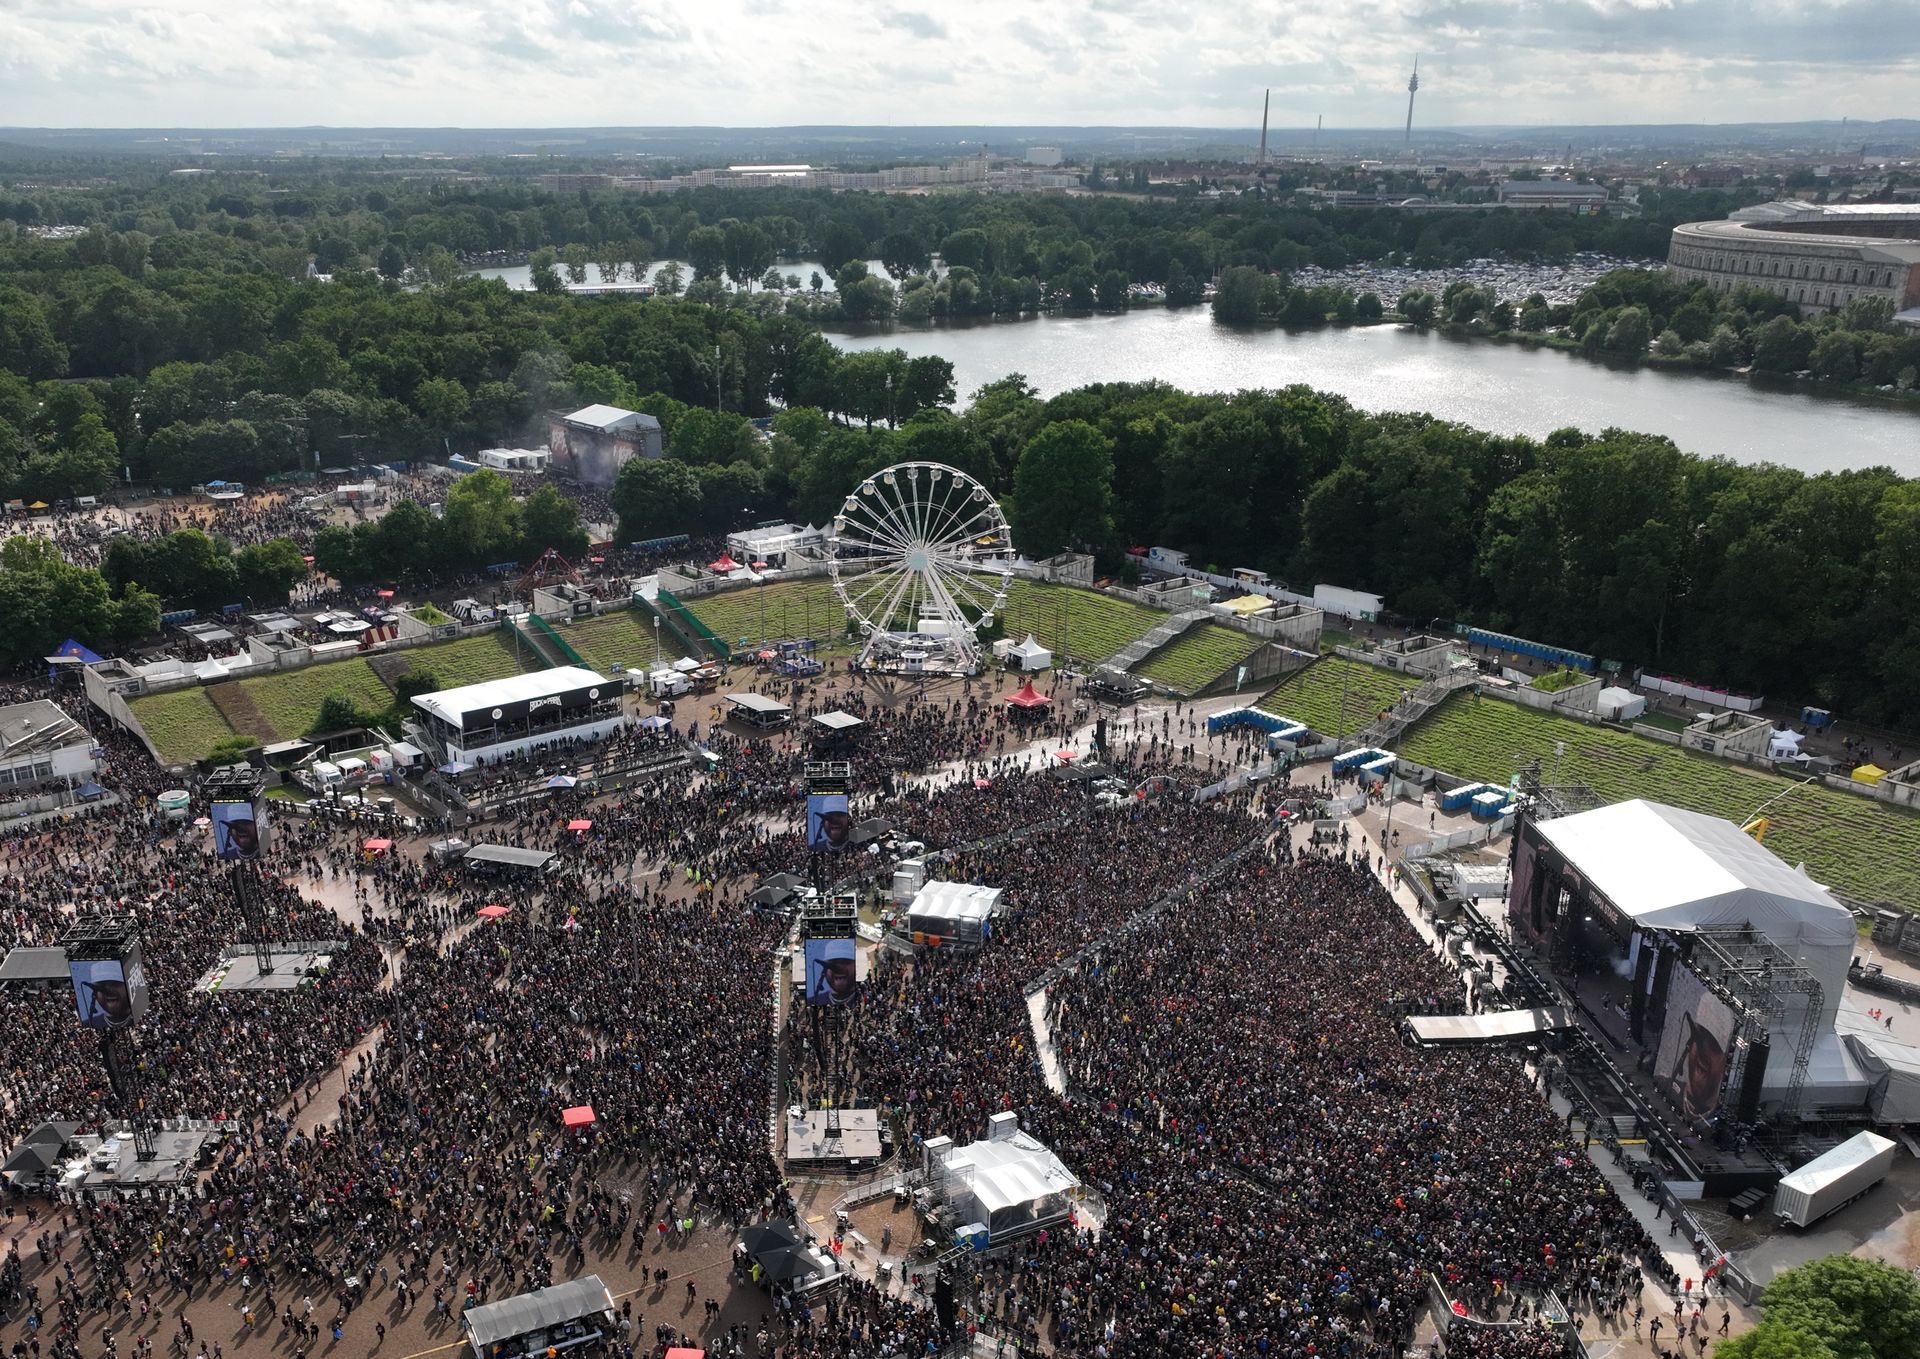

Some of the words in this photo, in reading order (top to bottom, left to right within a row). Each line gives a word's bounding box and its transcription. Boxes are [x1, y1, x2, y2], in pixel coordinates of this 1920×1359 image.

[529, 699, 544, 712] ROCK
[547, 695, 562, 706] PARK
[1604, 903, 1619, 925] STAGE
